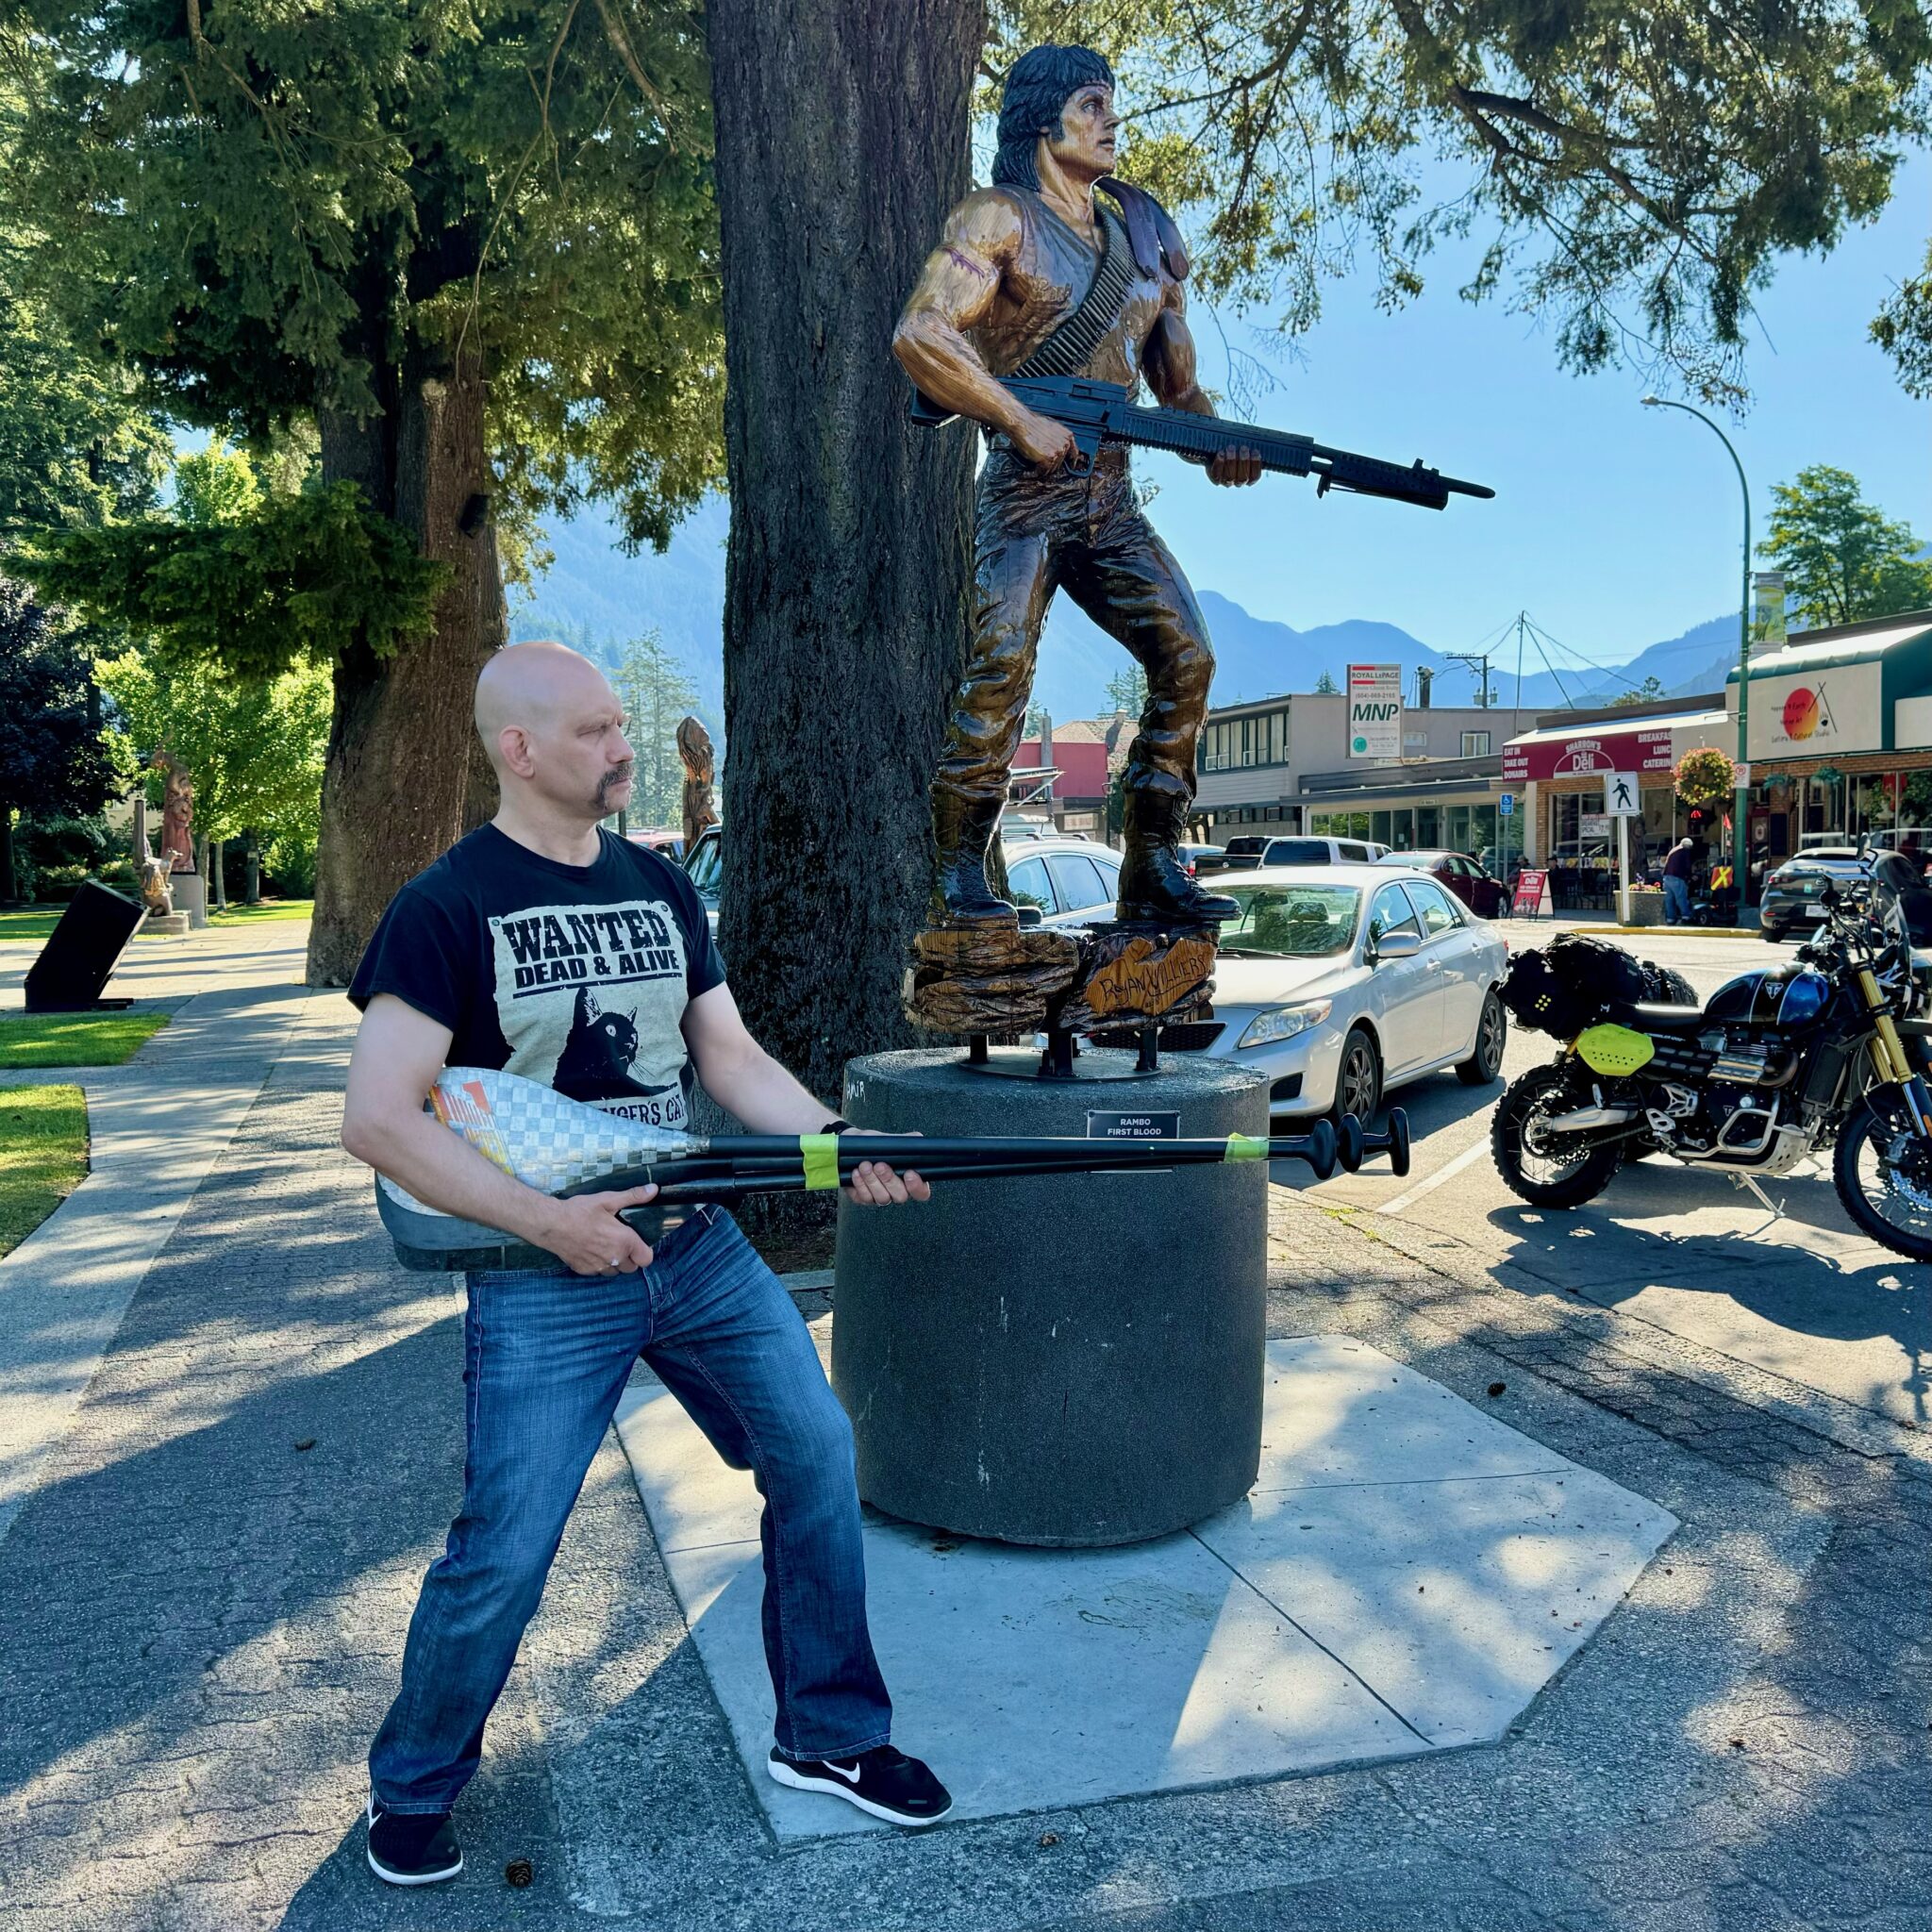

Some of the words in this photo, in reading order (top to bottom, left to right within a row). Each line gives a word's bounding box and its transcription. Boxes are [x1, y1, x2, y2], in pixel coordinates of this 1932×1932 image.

[1352, 703, 1399, 722] MNP
[1504, 747, 1513, 757] EAT
[1514, 746, 1521, 756] IN
[1504, 758, 1517, 768] TAKE
[1518, 758, 1528, 767] OUT
[1573, 753, 1594, 771] Deli
[501, 909, 672, 965] WANTED
[514, 958, 588, 990] DEAD
[593, 955, 611, 976] &
[619, 949, 680, 975] ALIVE
[1133, 1127, 1161, 1136] BLOOD
